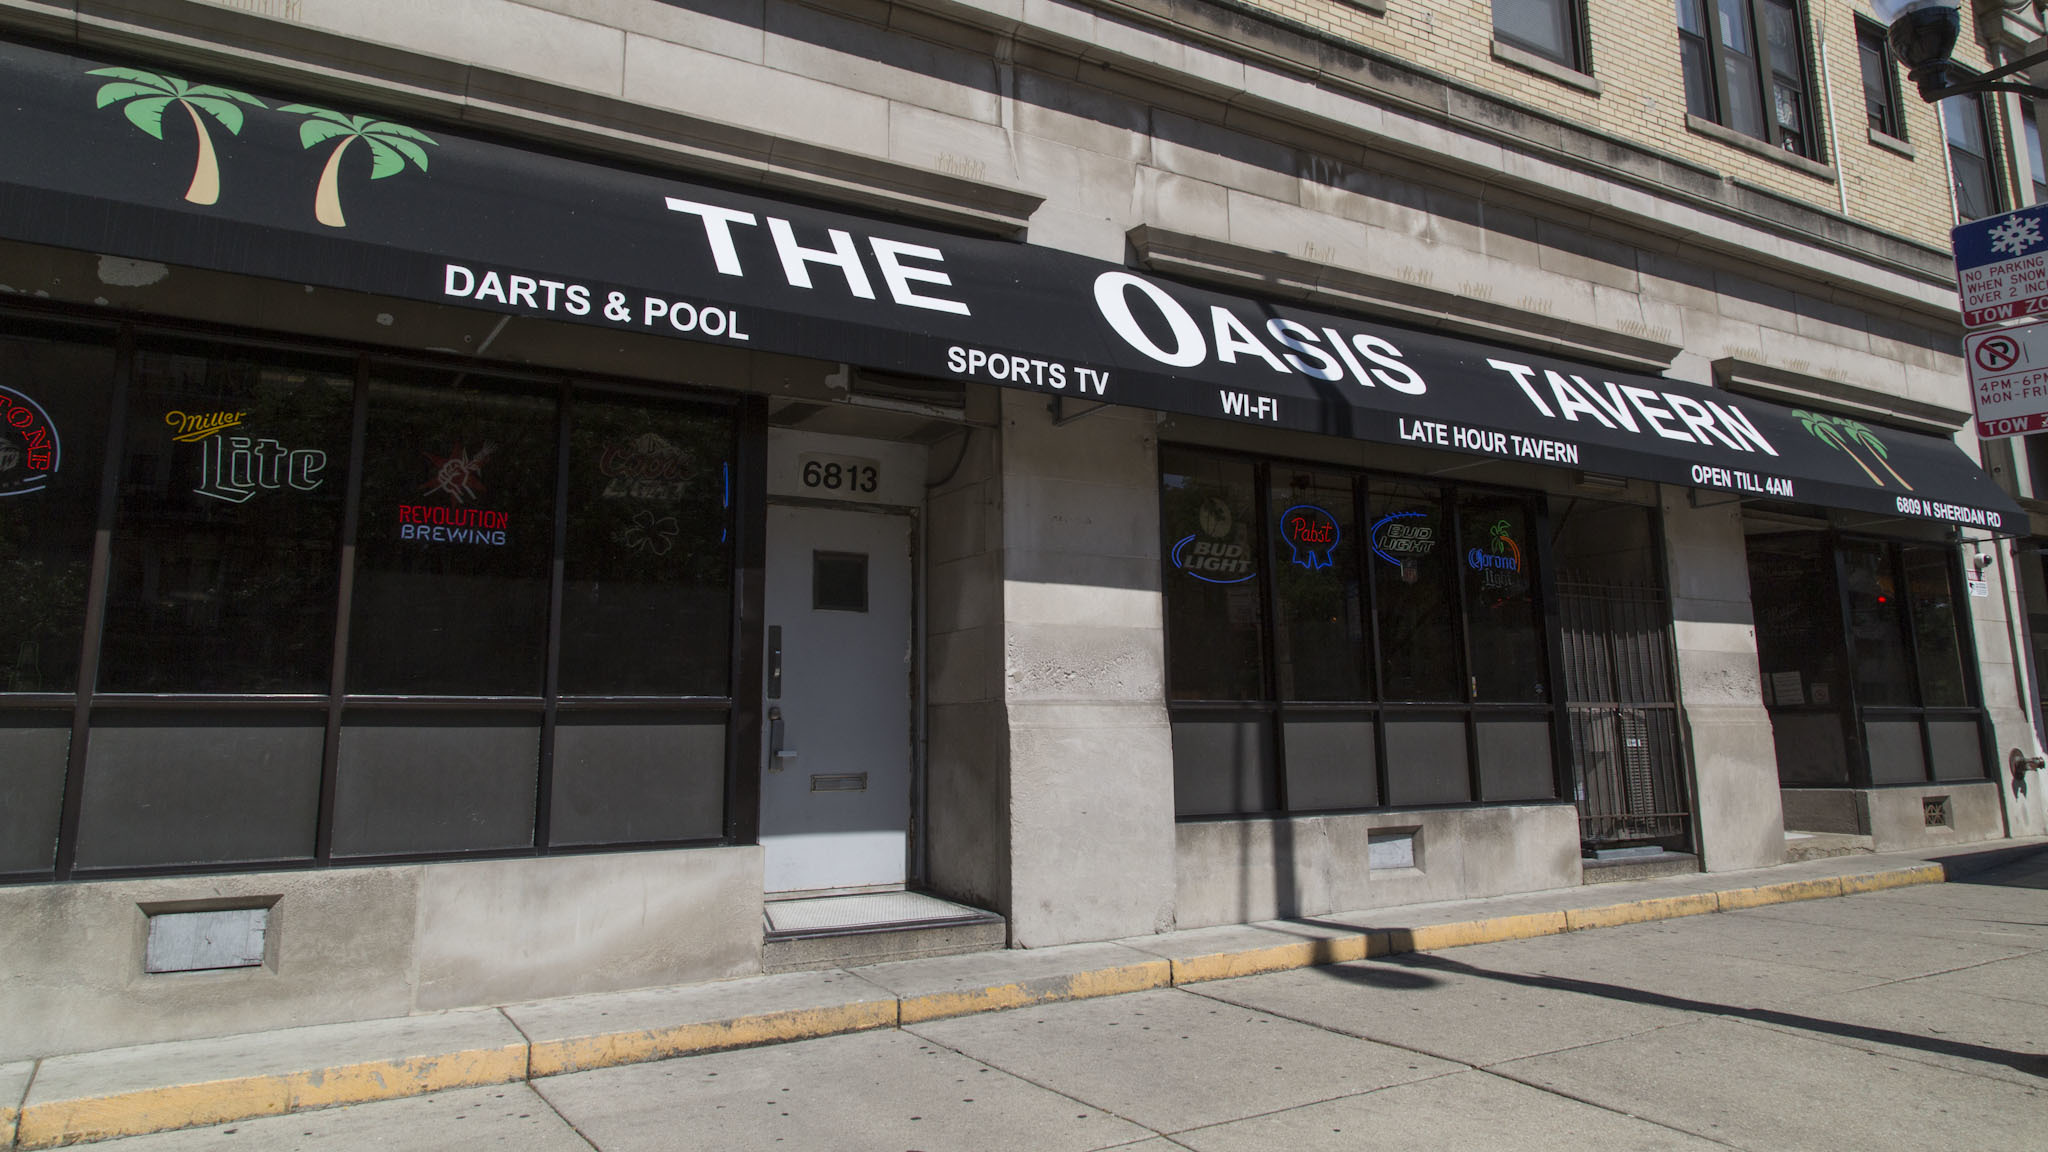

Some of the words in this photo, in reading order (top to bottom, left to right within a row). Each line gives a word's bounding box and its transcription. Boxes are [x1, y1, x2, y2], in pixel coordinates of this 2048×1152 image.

[1965, 271, 1982, 282] NO
[1989, 256, 2044, 277] PARKING
[1967, 279, 2002, 294] WHEN
[2010, 267, 2046, 285] SNOW
[444, 264, 591, 316] DARTS
[603, 291, 632, 323] &
[644, 296, 750, 341] POOL
[1969, 290, 2002, 306] OVER
[2009, 287, 2018, 297] 2
[664, 196, 972, 317] THE
[1093, 271, 1428, 396] OASIS
[1485, 357, 1780, 457] TAVERN
[1970, 303, 2014, 324] TOW
[947, 346, 1068, 389] SPORTS
[1073, 366, 1110, 396] TV
[1219, 389, 1279, 422] WI-FI
[165, 410, 248, 437] Miller
[1985, 416, 2029, 435] TOW
[1399, 417, 1449, 446] LATE
[1453, 426, 1509, 455] HOUR
[1510, 435, 1580, 465] TAVERN
[192, 434, 327, 503] Lite
[803, 460, 878, 492] 6813
[1691, 464, 1732, 488] OPEN
[1733, 470, 1764, 493] TILL
[1765, 476, 1795, 497] 4AM
[399, 504, 509, 530] REVOLUTION
[1896, 496, 1922, 516] 6809
[1923, 501, 1932, 517] N
[1933, 502, 1986, 526] SHERIDAN
[1987, 511, 2001, 528] RD
[400, 523, 507, 546] BREWING
[1291, 517, 1334, 543] Pabst
[1387, 523, 1433, 539] BUD
[1194, 541, 1244, 558] BUD
[1378, 538, 1436, 553] LIGHT
[1183, 556, 1251, 574] LIGHT
[1468, 547, 1517, 571] Corona
